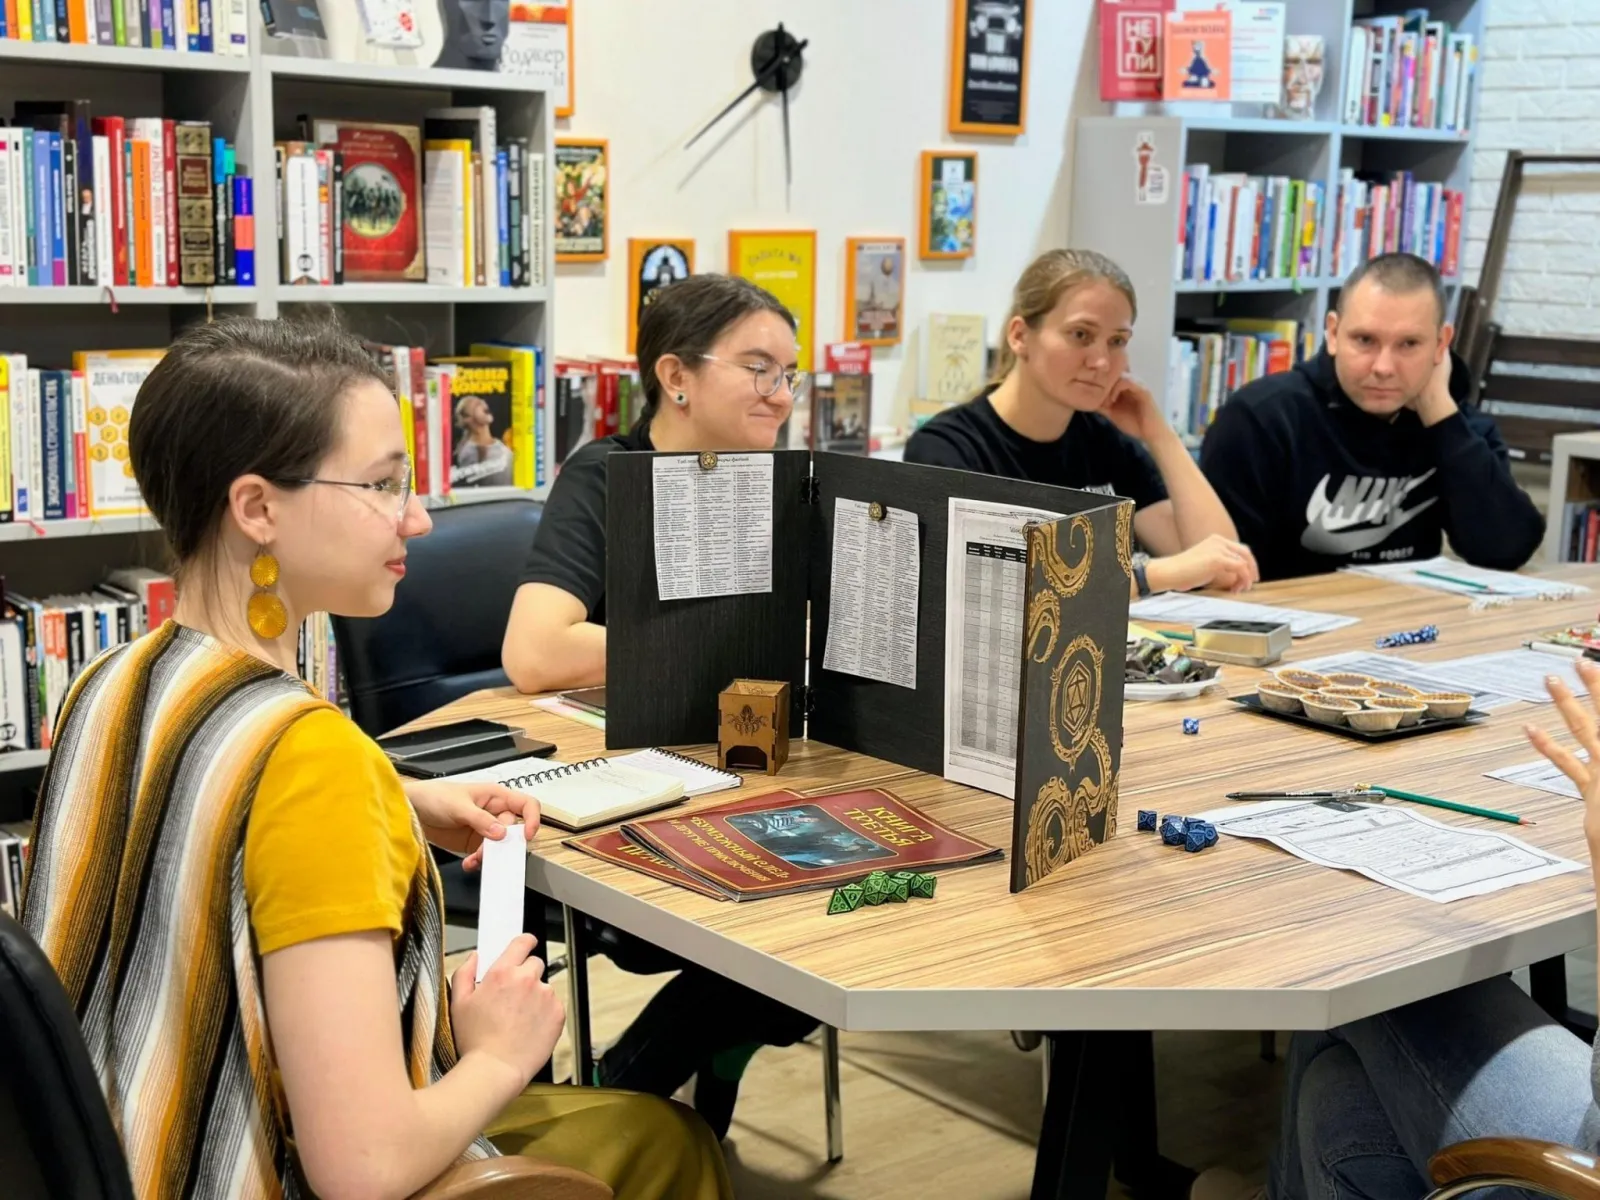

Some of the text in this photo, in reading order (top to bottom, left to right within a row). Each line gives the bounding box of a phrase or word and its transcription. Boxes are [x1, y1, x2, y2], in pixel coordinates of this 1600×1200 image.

[1125, 19, 1153, 37] НЕ
[1125, 54, 1154, 71] ПИ
[843, 808, 916, 847] ТРЕТЬЯ
[867, 807, 935, 842] КНИГА
[673, 824, 711, 848] ДРУГИЕ
[703, 845, 772, 882] ПРИКЛЮЧЕНИЯ
